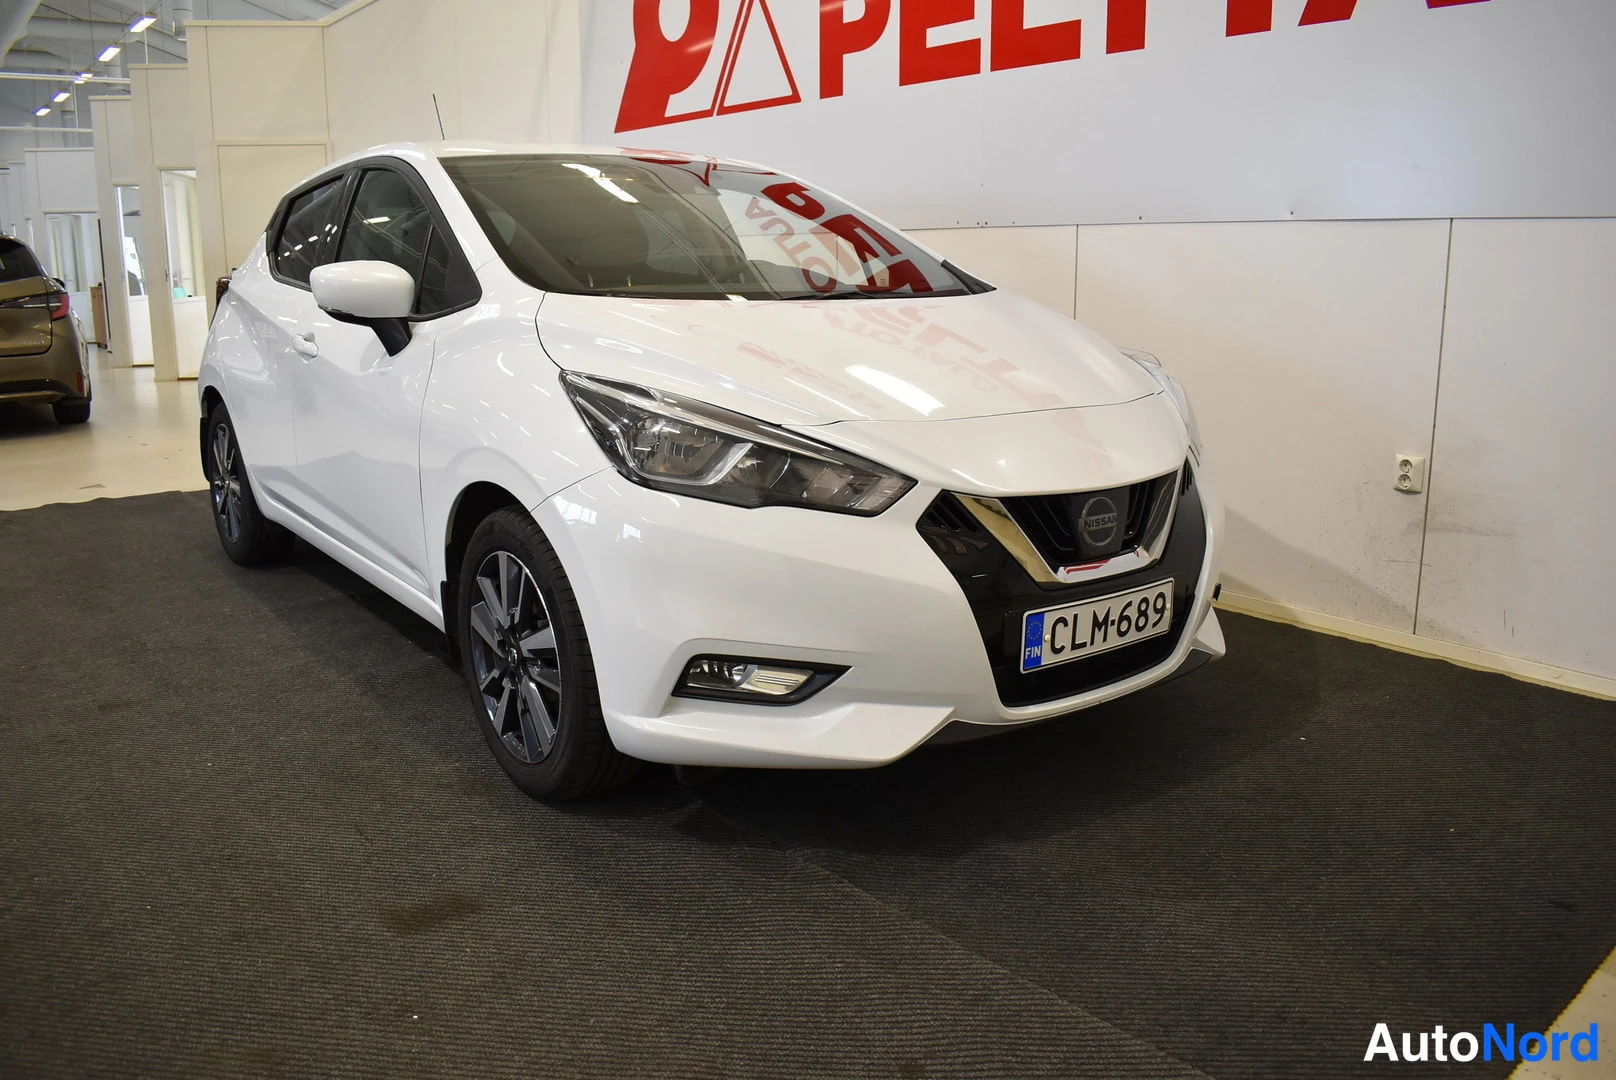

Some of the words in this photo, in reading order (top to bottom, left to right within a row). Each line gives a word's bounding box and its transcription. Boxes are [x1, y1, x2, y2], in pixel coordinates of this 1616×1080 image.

[1082, 513, 1118, 530] NISSAN
[1050, 591, 1167, 655] CLM-689
[1024, 644, 1042, 660] FIN
